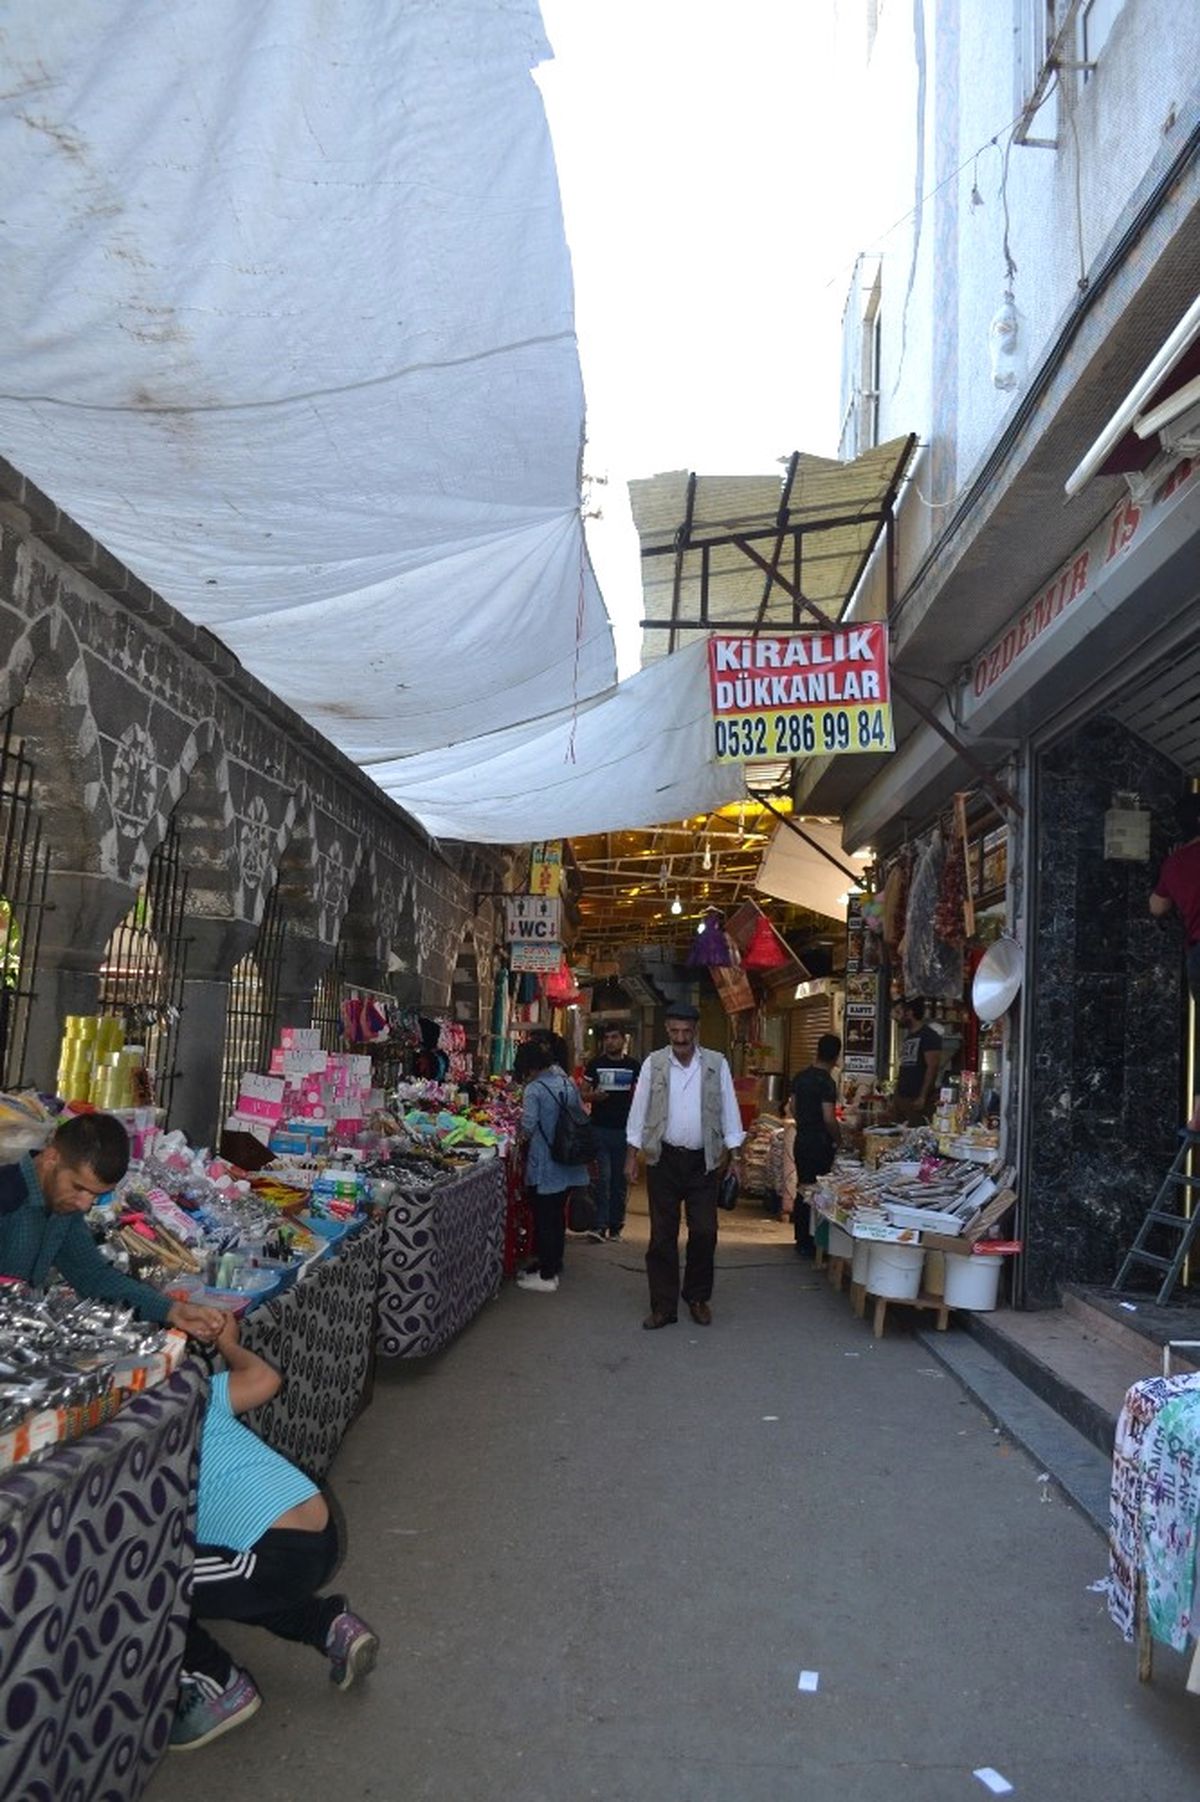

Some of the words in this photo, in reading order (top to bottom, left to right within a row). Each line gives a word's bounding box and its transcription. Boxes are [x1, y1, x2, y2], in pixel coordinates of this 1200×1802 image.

[716, 628, 875, 672] KİRALIK
[716, 669, 881, 710] DÜKKANLAR
[715, 716, 768, 757] 0532
[774, 712, 816, 753] 286
[822, 711, 850, 751] 99
[857, 708, 886, 748] 84
[518, 920, 548, 938] WC
